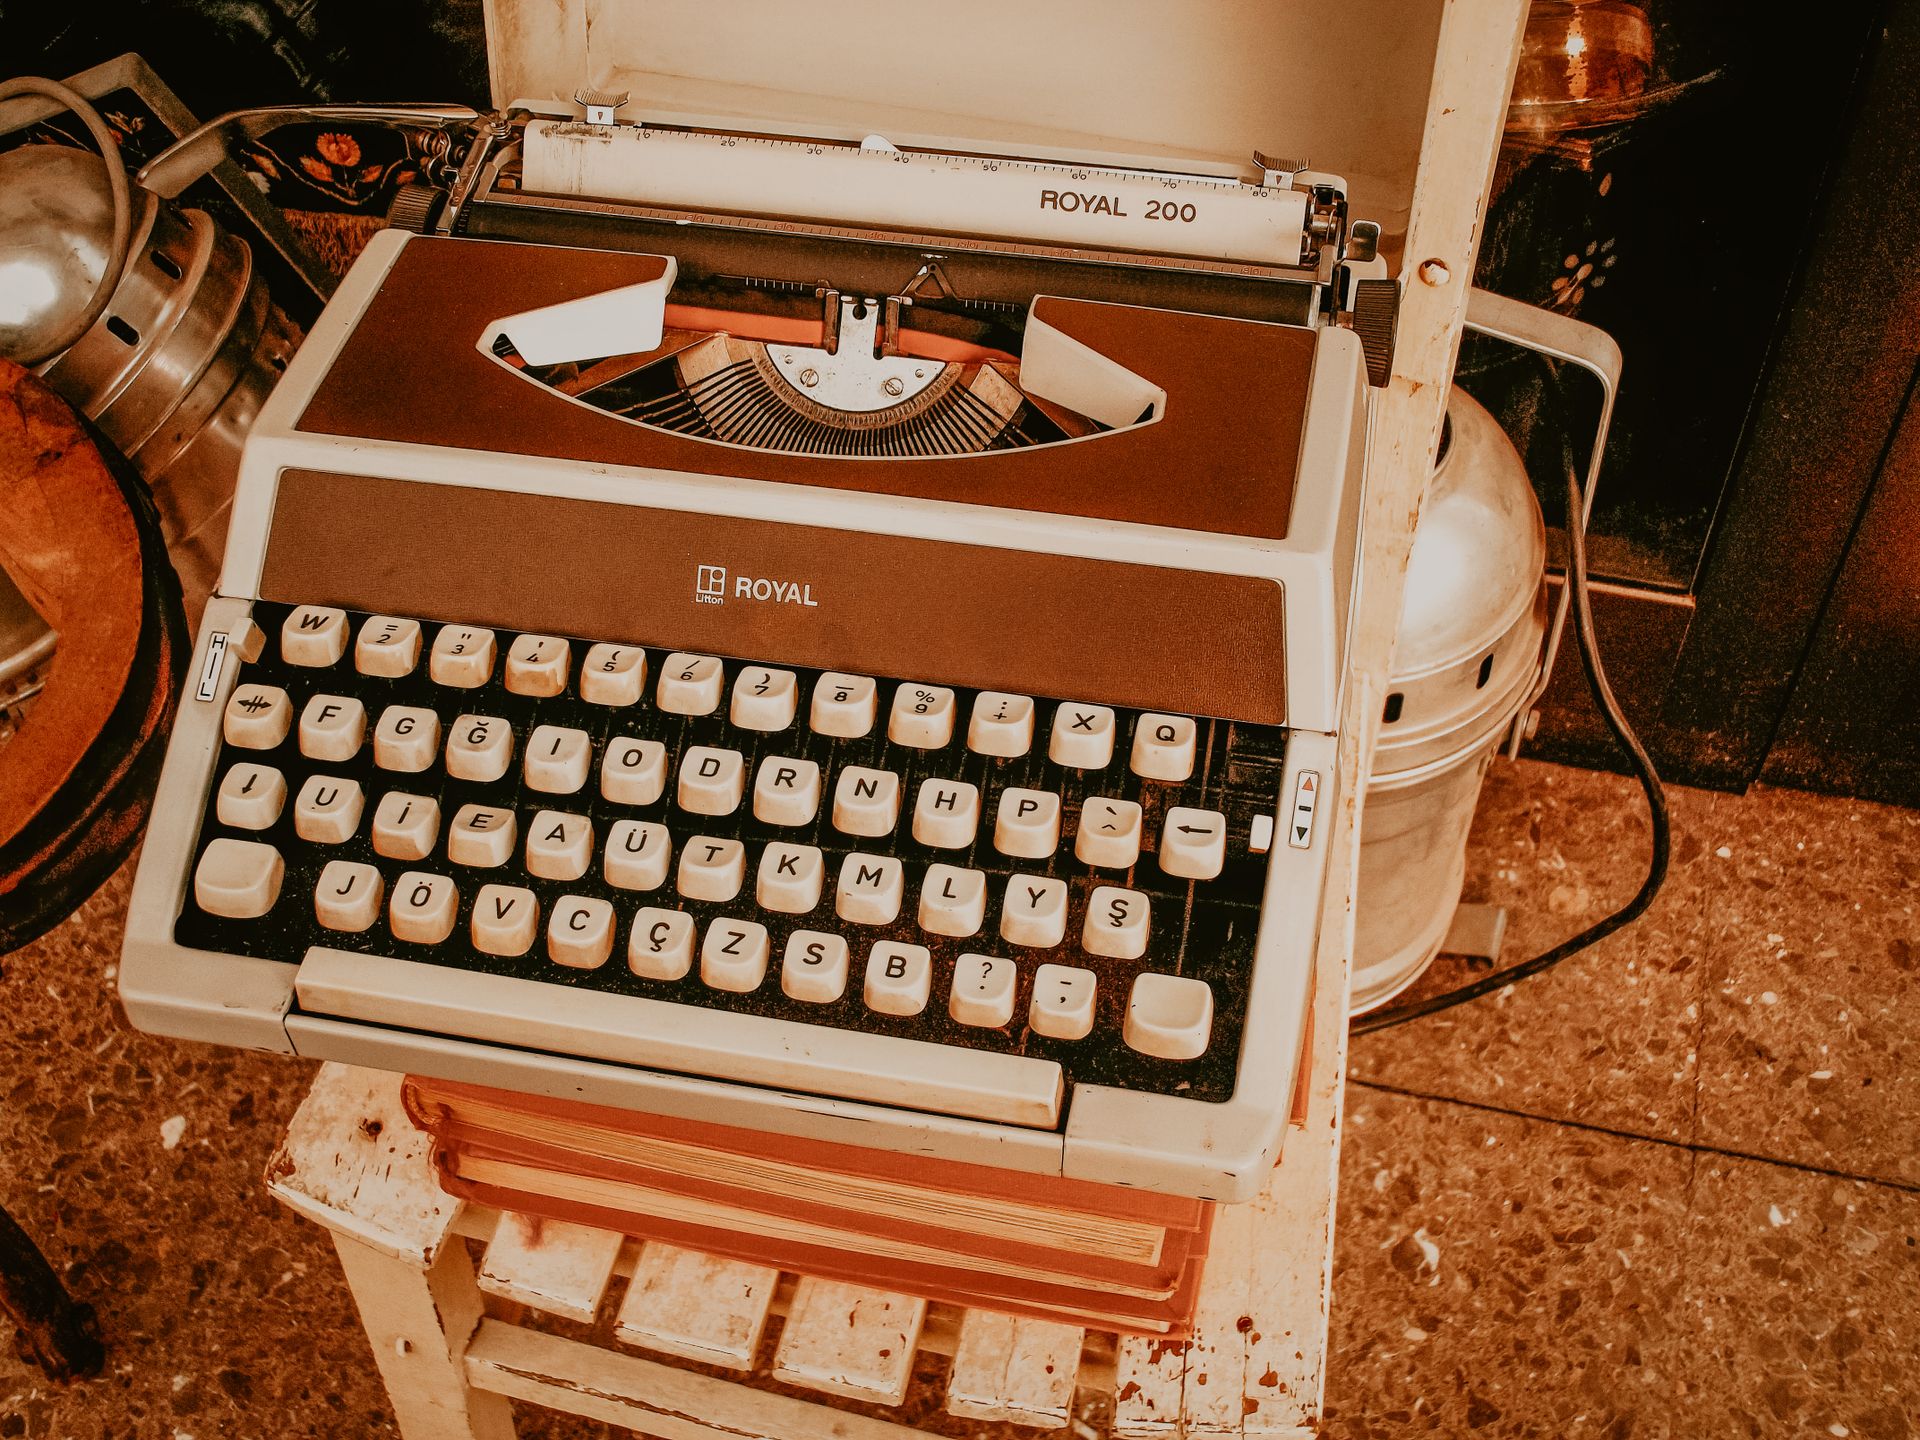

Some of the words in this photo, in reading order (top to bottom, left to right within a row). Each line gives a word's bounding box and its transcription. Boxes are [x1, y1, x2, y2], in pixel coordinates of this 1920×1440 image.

[720, 139, 736, 149] 20
[806, 147, 823, 156] 30
[894, 155, 909, 165] 40
[983, 163, 999, 173] 50
[1071, 172, 1087, 182] 60
[1161, 180, 1178, 190] 70
[1251, 189, 1269, 198] 80
[1039, 189, 1128, 218] ROYAL
[1143, 200, 1198, 224] 200
[695, 593, 724, 605] Litton
[735, 576, 818, 607] ROYAL
[300, 613, 330, 631] W
[211, 635, 225, 649] H
[375, 633, 392, 644] 2
[450, 644, 465, 655] 3
[525, 653, 539, 663] 4
[602, 661, 617, 672] 5
[679, 671, 694, 681] 6
[199, 682, 212, 697] L
[754, 684, 770, 696] 7
[833, 691, 848, 702] 8
[915, 690, 936, 703] %
[317, 705, 342, 723] F
[914, 703, 928, 714] 9
[394, 717, 416, 735] G
[1071, 712, 1096, 731] X
[467, 721, 490, 745] Ğ
[1155, 724, 1176, 743] Q
[550, 737, 561, 756] I
[622, 748, 643, 768] O
[698, 757, 721, 778] D
[774, 767, 797, 788] R
[315, 786, 339, 807] U
[854, 778, 878, 799] N
[934, 790, 957, 811] H
[1017, 799, 1039, 818] P
[469, 813, 494, 829] E
[544, 823, 566, 843] A
[625, 828, 648, 853] Ü
[704, 845, 724, 862] T
[777, 854, 800, 876] K
[336, 875, 356, 895] J
[855, 864, 884, 888] M
[409, 881, 433, 907] Ö
[942, 877, 957, 899] L
[1027, 886, 1047, 909] Y
[495, 897, 516, 920] V
[1108, 898, 1129, 928] Ş
[569, 909, 591, 931] C
[649, 921, 671, 953] Ç
[721, 931, 746, 955] Z
[802, 942, 826, 965] S
[885, 954, 907, 979] B
[982, 961, 993, 979] ?
